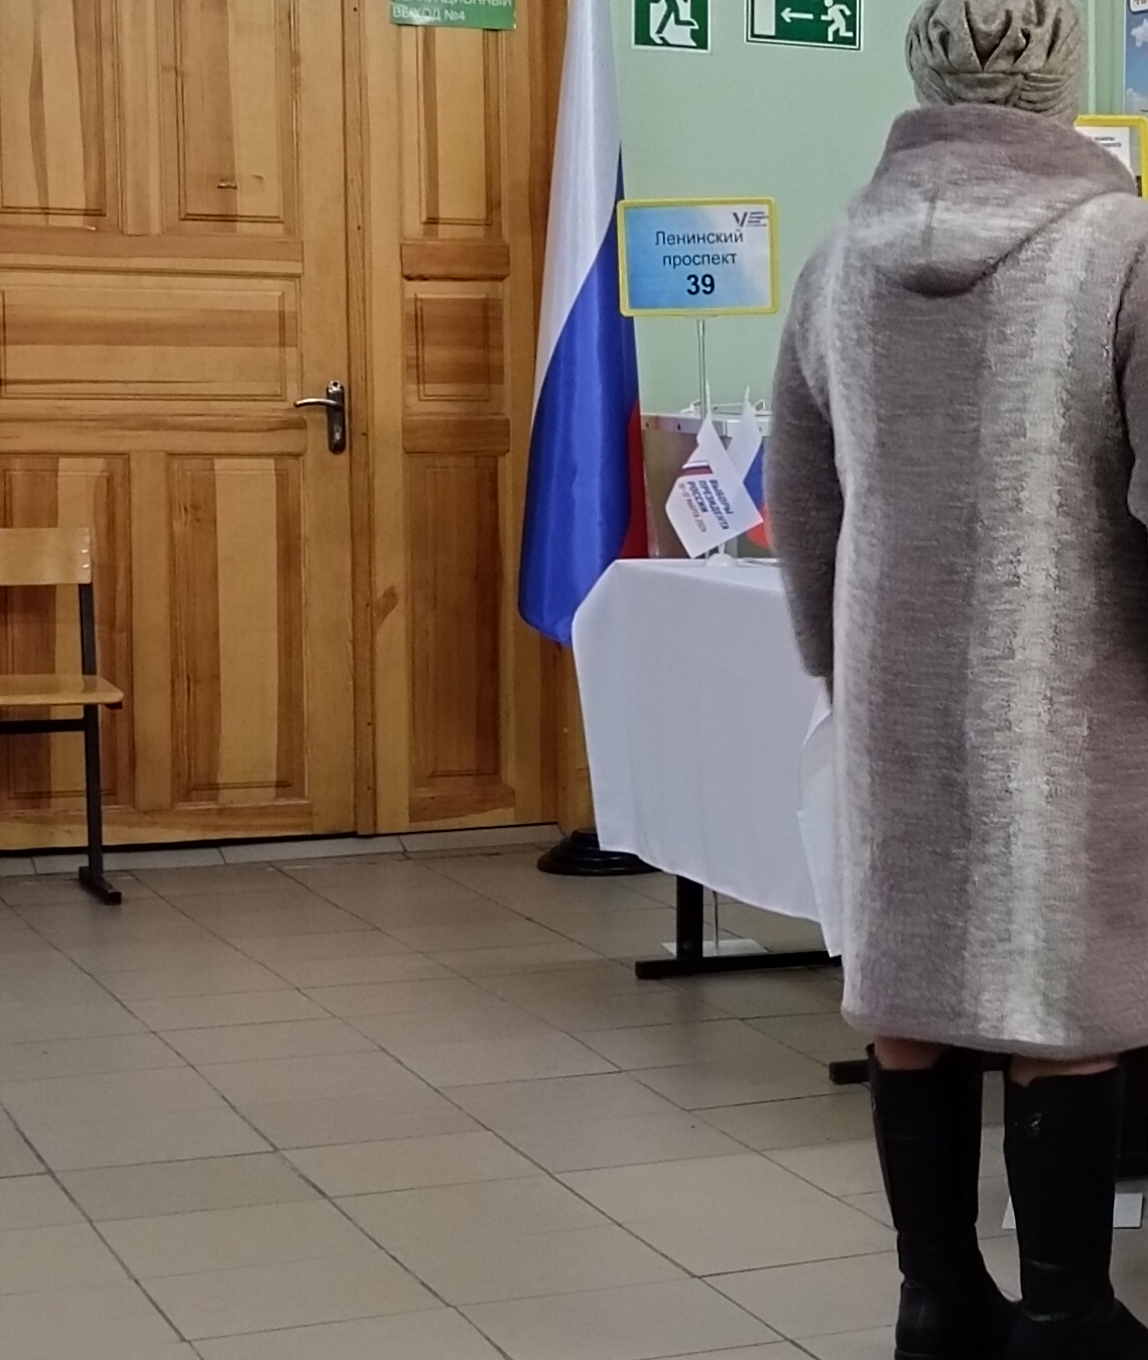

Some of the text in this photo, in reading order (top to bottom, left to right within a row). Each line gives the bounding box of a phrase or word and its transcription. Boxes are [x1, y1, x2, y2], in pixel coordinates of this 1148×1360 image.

[391, 6, 442, 22] ВЫХОД
[655, 228, 744, 246] Ленинский
[662, 252, 738, 270] проспект
[686, 273, 716, 296] 39
